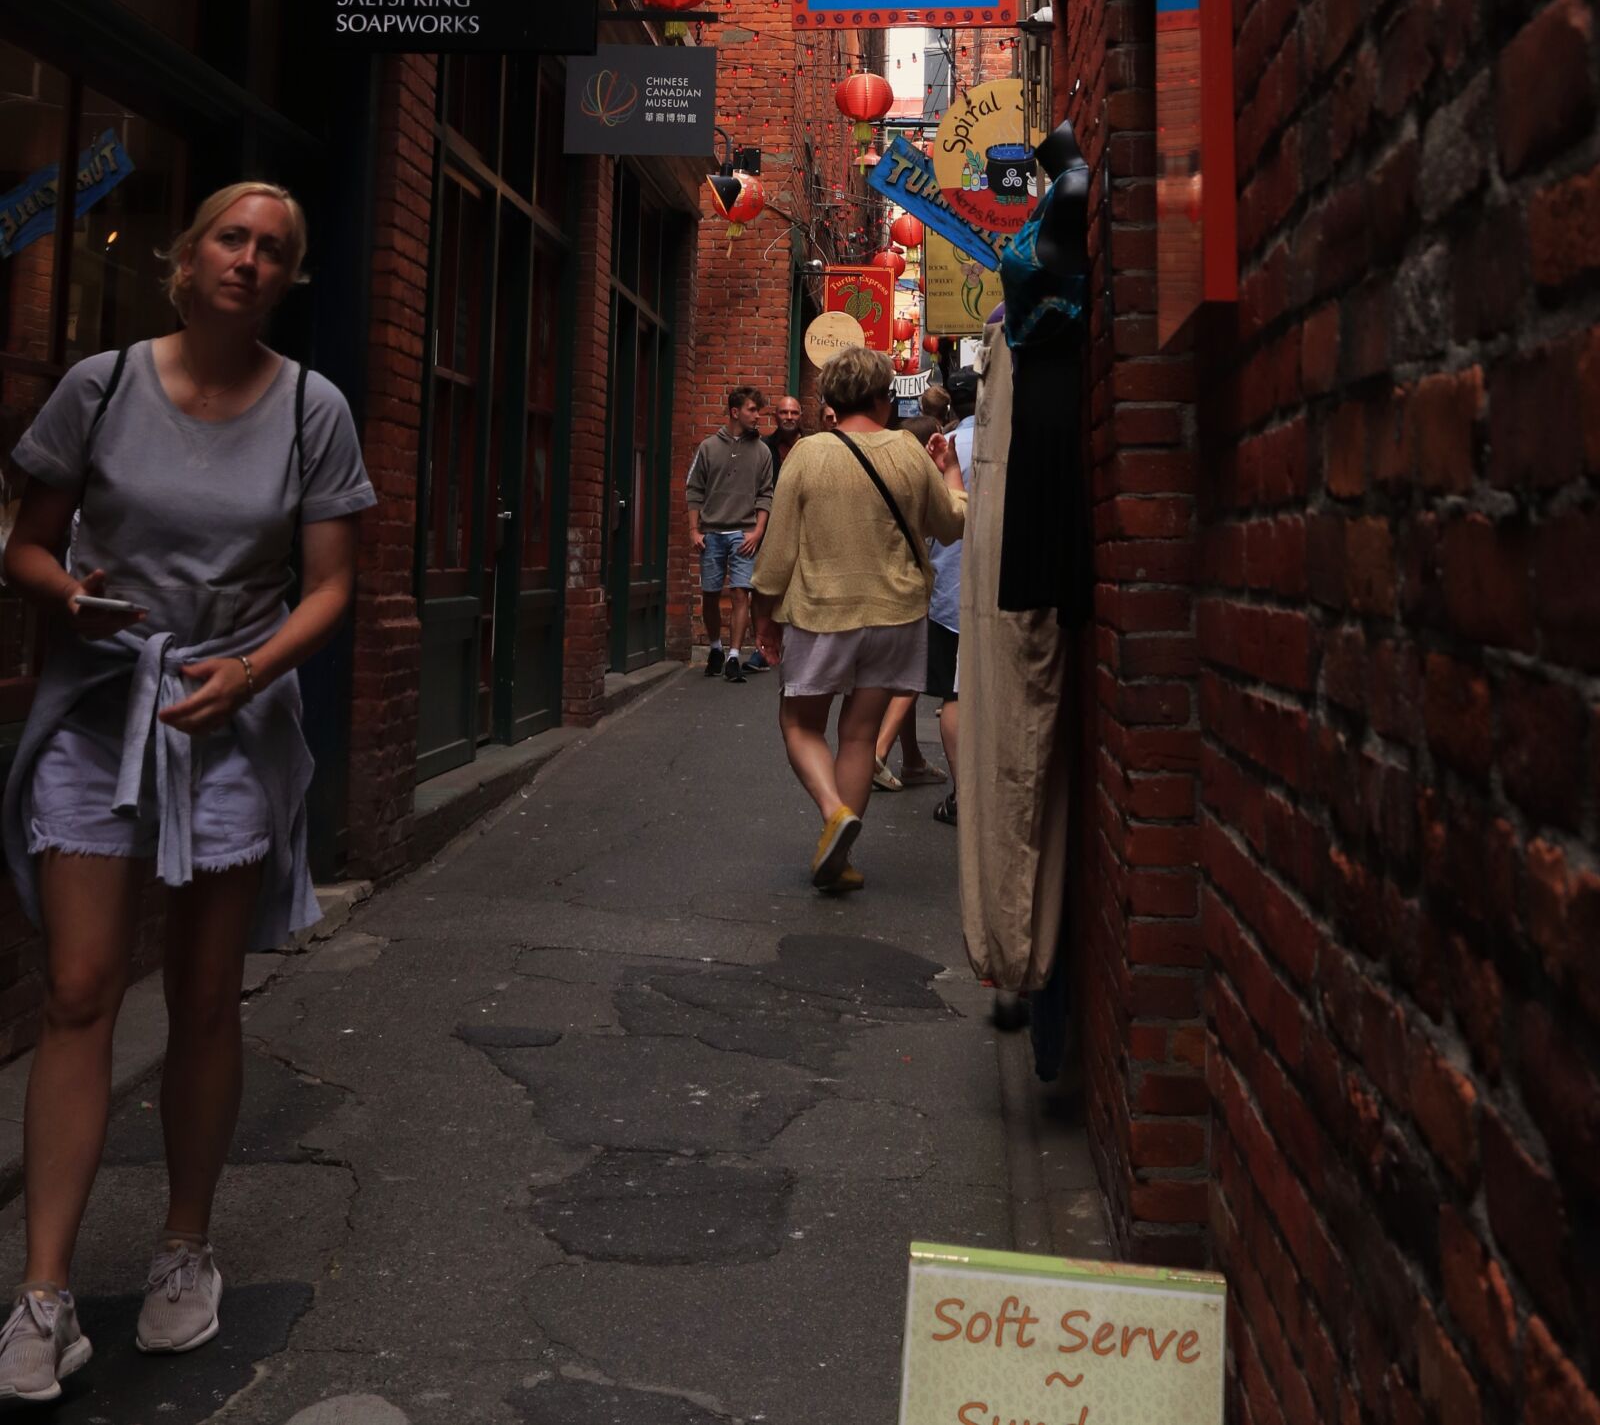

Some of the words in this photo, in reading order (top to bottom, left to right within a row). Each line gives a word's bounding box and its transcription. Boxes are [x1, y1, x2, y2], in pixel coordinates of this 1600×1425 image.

[335, 13, 480, 35] SOAPWORKS
[646, 76, 689, 87] CHINESE
[645, 87, 702, 98] CANADIAN
[645, 98, 689, 109] MUSEUM
[645, 112, 697, 124] 華裔博物館
[943, 91, 1002, 154] Spiral
[830, 276, 856, 290] Turtle
[859, 274, 889, 297] Express
[928, 278, 953, 286] JEWELRY
[810, 335, 856, 348] Priestess
[932, 1296, 1039, 1348] Soft
[1058, 1310, 1201, 1363] Serve
